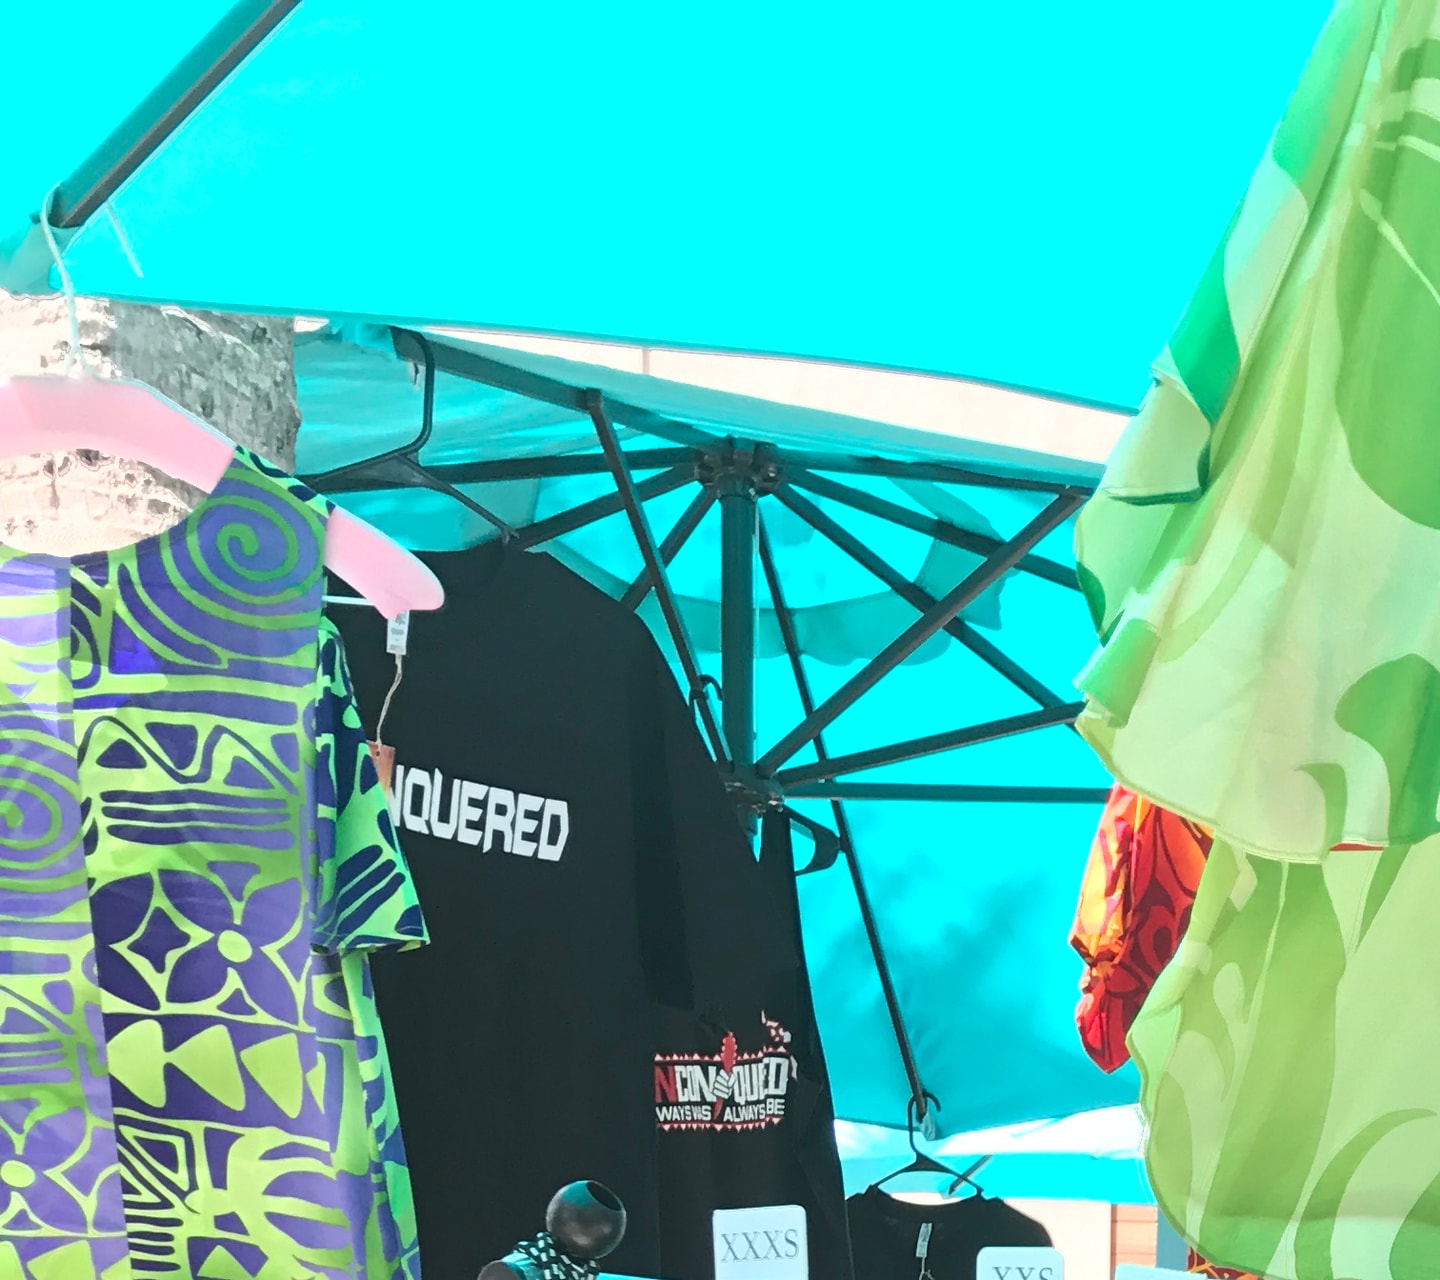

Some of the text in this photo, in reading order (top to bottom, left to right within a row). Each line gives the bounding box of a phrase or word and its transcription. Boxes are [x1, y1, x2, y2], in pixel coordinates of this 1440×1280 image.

[723, 1103, 766, 1122] ALWAYS
[766, 1098, 786, 1115] BE
[721, 1228, 800, 1263] XXXS
